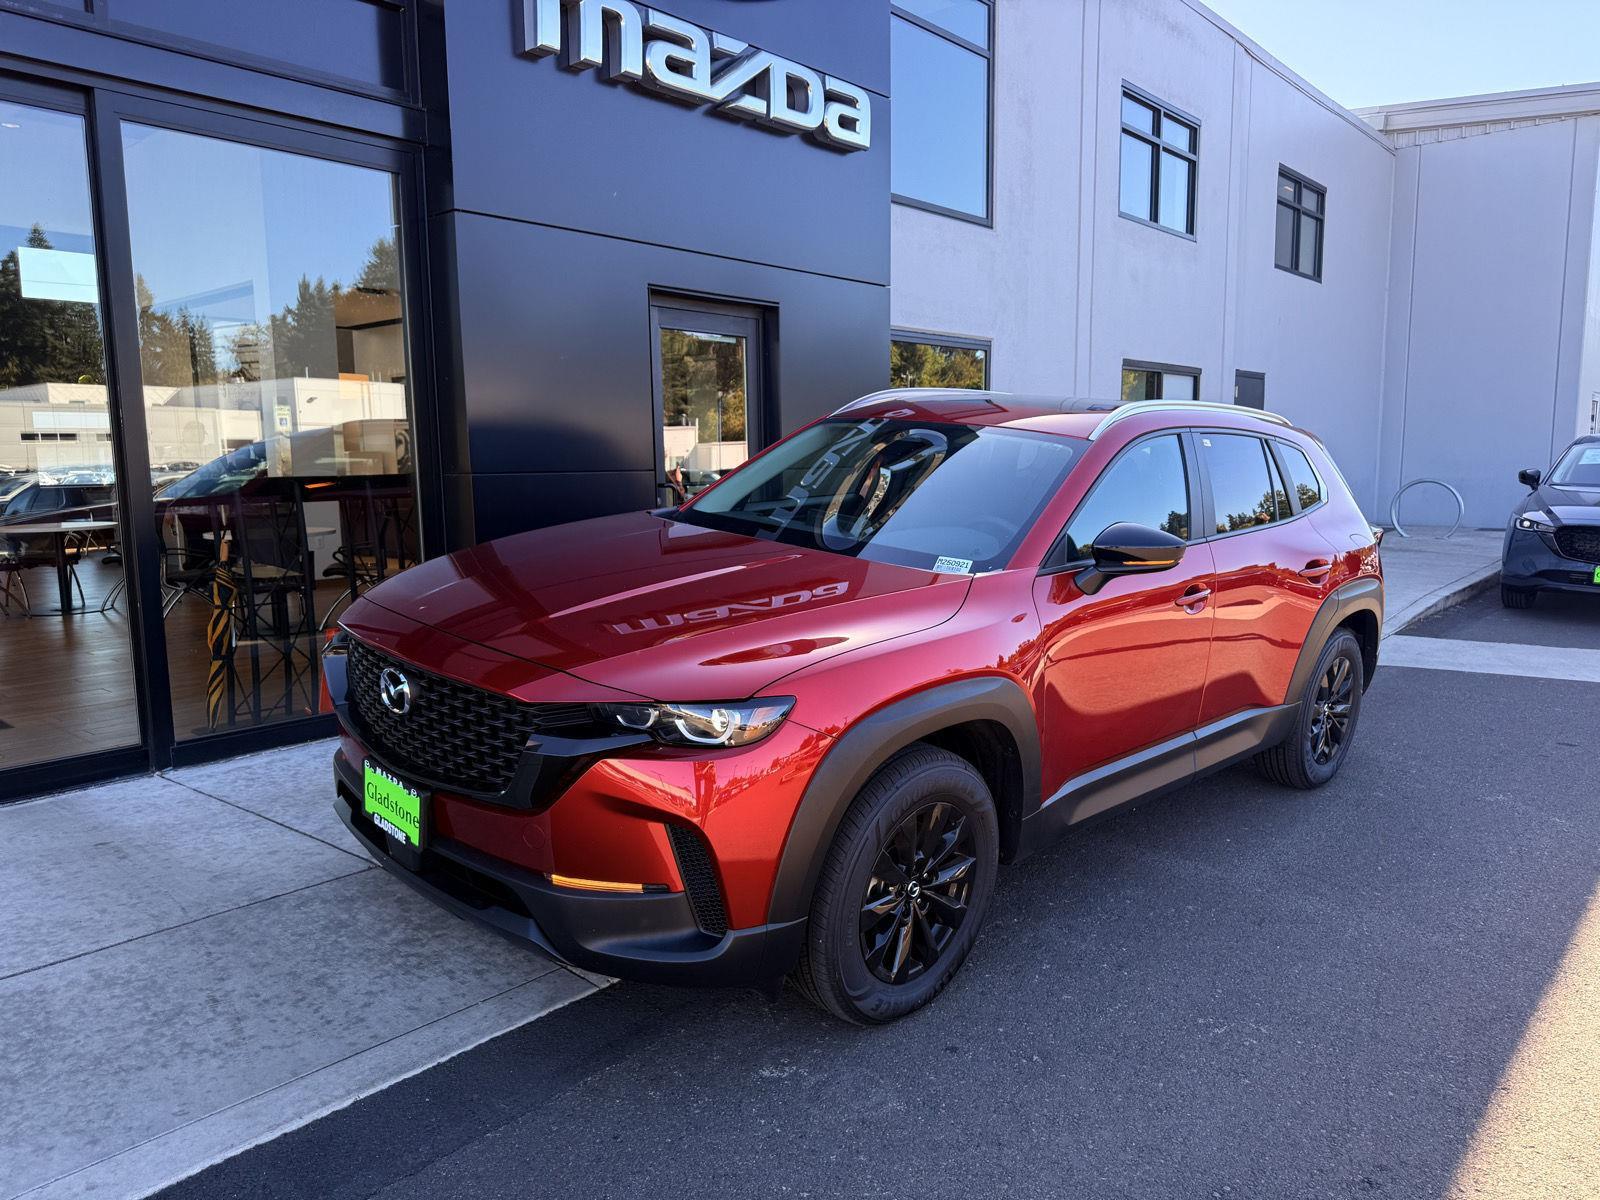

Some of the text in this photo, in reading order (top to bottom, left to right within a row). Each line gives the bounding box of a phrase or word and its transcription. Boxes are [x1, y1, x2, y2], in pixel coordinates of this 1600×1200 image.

[376, 767, 404, 789] MAZDA
[366, 781, 420, 829] Gladstone
[374, 813, 406, 844] GLADSTONE
